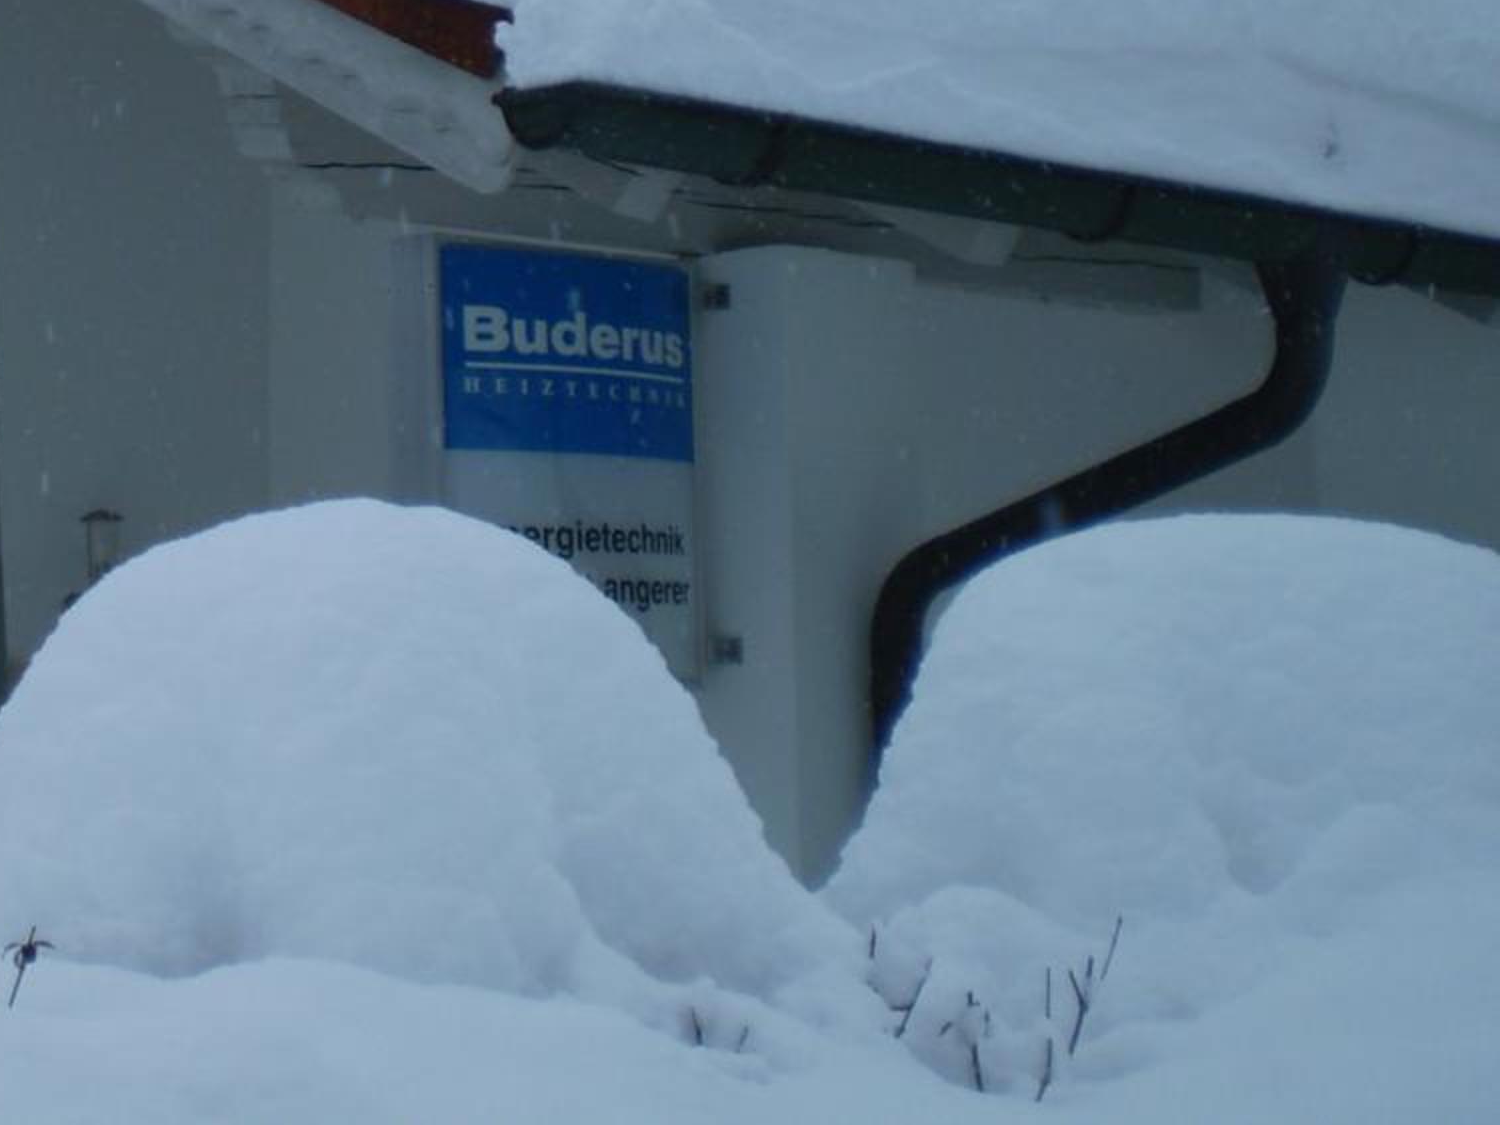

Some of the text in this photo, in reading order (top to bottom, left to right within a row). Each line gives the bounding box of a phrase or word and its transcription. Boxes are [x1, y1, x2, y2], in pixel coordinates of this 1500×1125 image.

[462, 304, 684, 367] Buderus
[509, 520, 687, 560] ergietechnik
[586, 573, 690, 613] angerer
